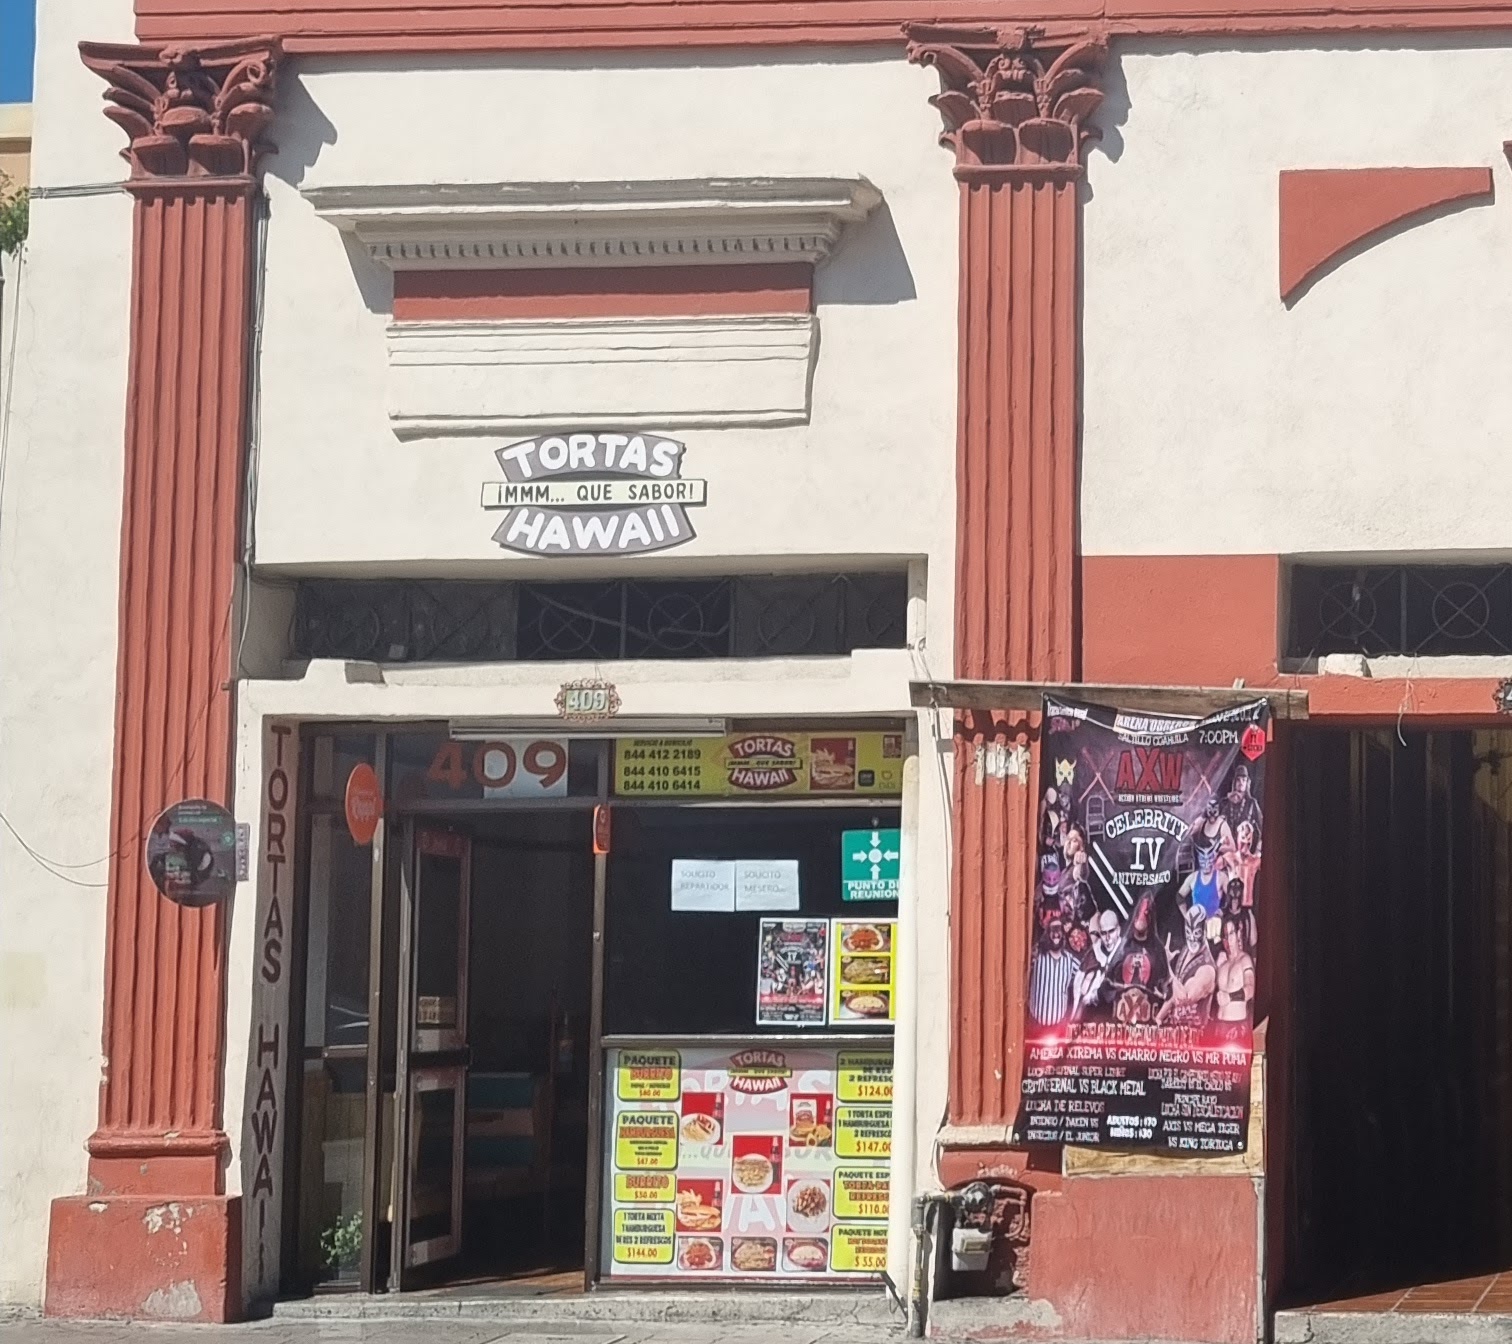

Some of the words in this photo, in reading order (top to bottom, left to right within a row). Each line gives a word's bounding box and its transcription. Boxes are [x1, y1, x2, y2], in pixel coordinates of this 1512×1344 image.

[502, 434, 678, 478] TORTAS
[576, 483, 612, 502] QUE
[628, 482, 694, 501] SABOR!
[506, 503, 679, 550] HAWAII
[567, 688, 608, 712] 409
[1199, 729, 1239, 745] 7:00PM
[624, 749, 646, 760] 844
[649, 749, 670, 760] 412
[673, 749, 701, 760] 2189
[734, 738, 793, 757] TORTAS
[426, 739, 568, 791] 409
[623, 766, 645, 777] 844
[648, 766, 669, 776] 410
[672, 766, 701, 776] 6415
[1115, 745, 1183, 792] AXW
[623, 780, 645, 791] 844
[648, 780, 669, 790] 410
[672, 780, 701, 790] 6414
[732, 768, 789, 786] HAWAII
[1105, 808, 1189, 842] CELEBRITY
[261, 725, 292, 984] TORTAS
[1130, 837, 1165, 870] IV
[848, 880, 885, 891] PUNTO
[623, 1055, 676, 1066] PAQUETE
[1105, 1047, 1117, 1060] VS
[1118, 1047, 1157, 1062] CHARRO
[1159, 1050, 1190, 1063] NEGRO
[1192, 1051, 1204, 1064] VS
[1206, 1051, 1220, 1065] MR
[1222, 1052, 1247, 1066] PUMA
[733, 1075, 782, 1092] HAWAII
[1079, 1078, 1090, 1094] VS
[1091, 1079, 1117, 1095] BLACK
[1119, 1080, 1147, 1096] METAL
[1054, 1100, 1066, 1112] DE
[1068, 1100, 1105, 1114] RELEVOS
[622, 1115, 674, 1125] PAQUETE
[854, 1129, 859, 1137] 2
[838, 1170, 874, 1179] PAQUETE
